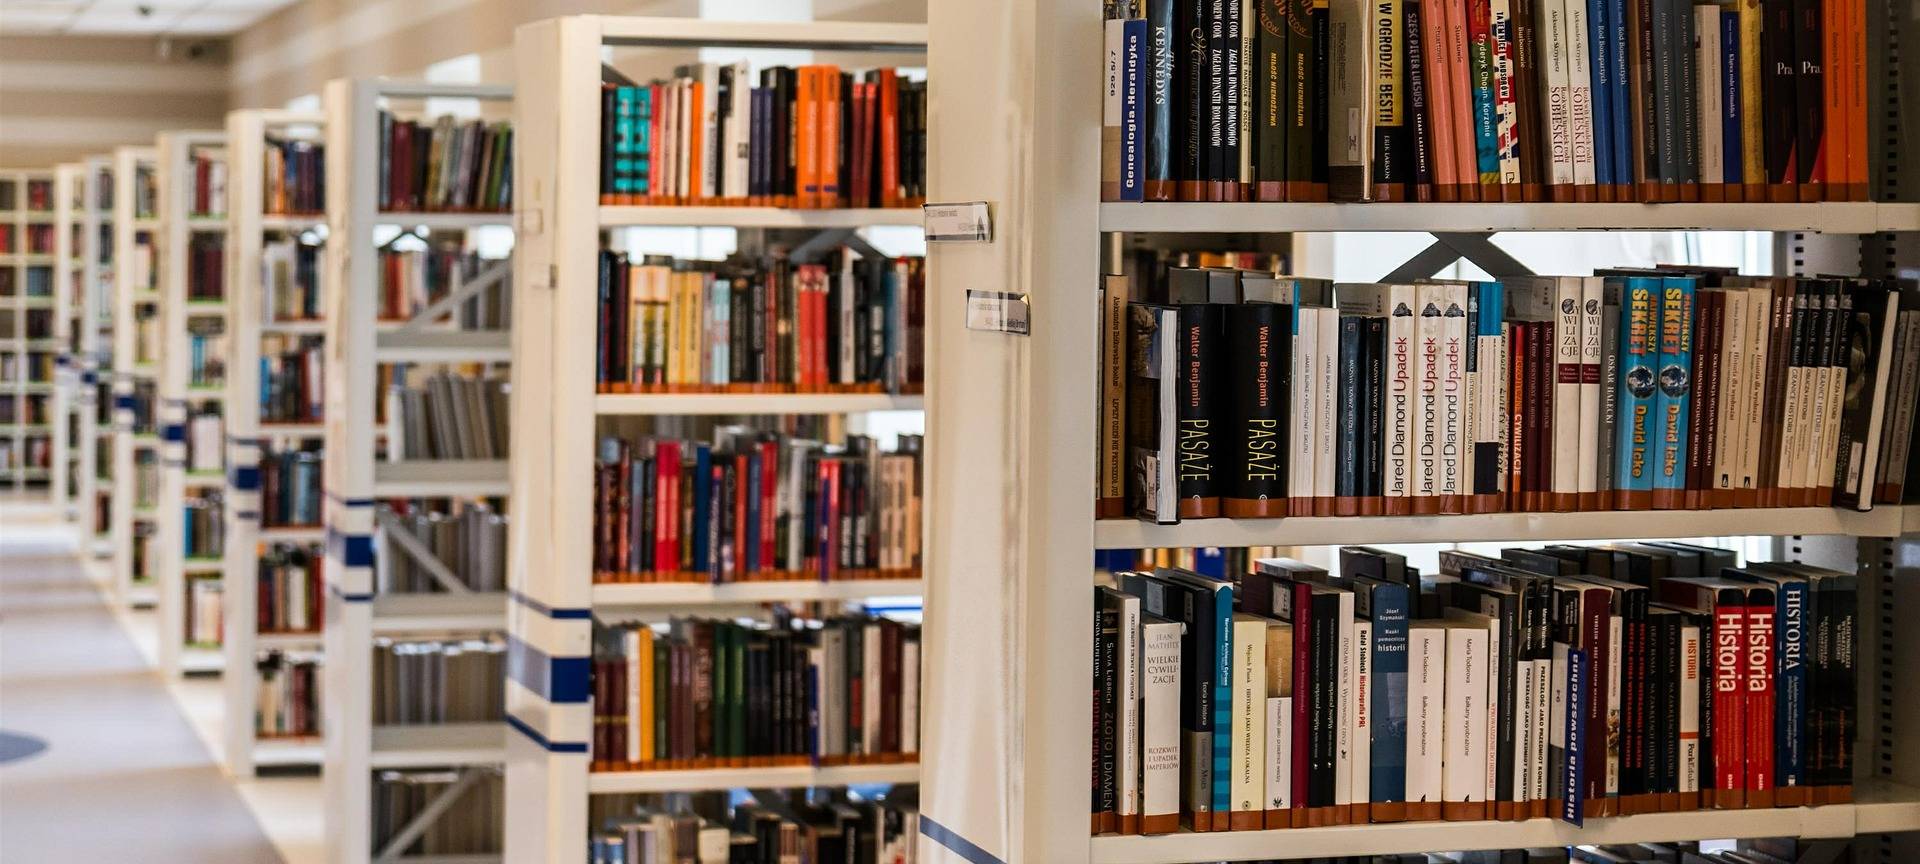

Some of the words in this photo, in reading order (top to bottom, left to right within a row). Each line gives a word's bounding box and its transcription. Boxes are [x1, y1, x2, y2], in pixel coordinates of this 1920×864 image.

[1380, 3, 1392, 14] W
[1212, 21, 1223, 38] COOK
[1229, 21, 1239, 38] COOK
[1379, 19, 1392, 79] OGRODZIE
[1496, 12, 1506, 51] TAJEMNICE
[1155, 26, 1166, 105] KENNEDYS
[1166, 50, 1176, 80] The
[1478, 34, 1488, 69] Fryderyk
[1598, 41, 1607, 84] Bonapartych
[1617, 42, 1627, 85] Bonapartych
[1412, 71, 1423, 108] LUKSUSU
[1499, 55, 1509, 98] WINDSORÓW
[1125, 35, 1138, 188] Genealogia.Heraldyka
[1482, 104, 1491, 138] Korzenie
[1551, 87, 1563, 163] SOBIESKICH
[1573, 87, 1585, 163] SOBIESKICH
[1564, 316, 1577, 325] WI
[1588, 316, 1600, 325] WI
[1630, 289, 1648, 356] SEKRET
[1663, 288, 1682, 355] SEKRET
[1191, 326, 1201, 357] Walter
[1259, 326, 1269, 357] Walter
[1561, 347, 1579, 357] CJE
[1564, 336, 1577, 345] ZA
[1585, 347, 1600, 357] CJE
[1587, 336, 1599, 346] ZA
[1393, 337, 1409, 391] Upadek
[1422, 337, 1438, 391] Upadek
[1445, 337, 1461, 391] Upadek
[1608, 355, 1616, 383] OSKAR
[1754, 354, 1762, 379] Historia
[1189, 361, 1201, 407] Benjamin
[1257, 361, 1269, 407] Benjamin
[1392, 395, 1405, 455] Diamond
[1421, 395, 1434, 455] Diamond
[1443, 395, 1456, 455] Diamond
[1606, 387, 1615, 424] HALECKI
[1634, 404, 1647, 443] David
[1667, 404, 1680, 443] David
[1181, 419, 1213, 481] PASAŻE
[1248, 419, 1280, 481] PASAŻE
[1513, 414, 1523, 475] CYWILIZACJE
[1632, 447, 1645, 477] Icke
[1664, 447, 1676, 477] Icke
[1392, 459, 1404, 497] Jared
[1421, 459, 1433, 497] Jared
[1443, 459, 1455, 495] Jared
[1359, 630, 1367, 647] Rafał
[1785, 590, 1801, 670] HISTORIA
[1106, 642, 1114, 667] SILVIA
[1148, 656, 1179, 664] WIELKIE
[1688, 639, 1697, 679] HISTORIA
[1719, 613, 1742, 691] Historia
[1749, 613, 1772, 691] Historia
[1152, 675, 1175, 683] ZACJE
[1358, 675, 1367, 715] Historiografia
[1569, 653, 1580, 752] powszechna
[1566, 756, 1577, 819] Historia
